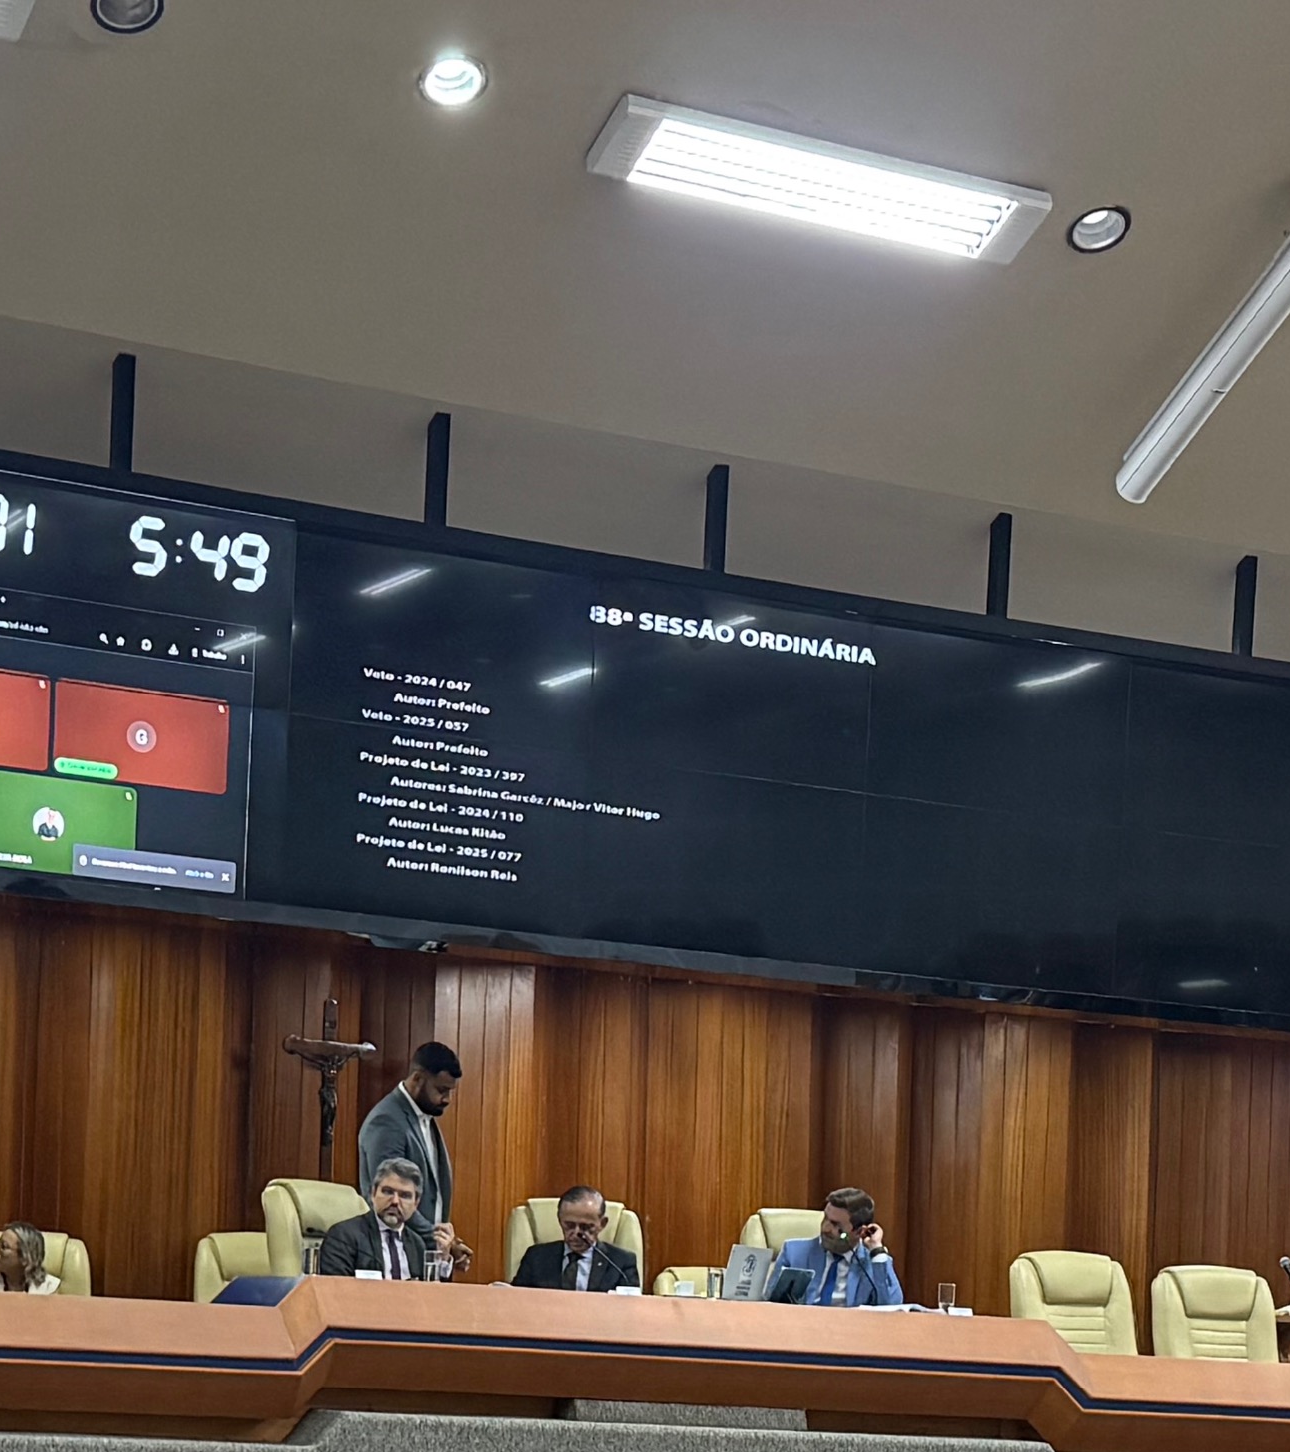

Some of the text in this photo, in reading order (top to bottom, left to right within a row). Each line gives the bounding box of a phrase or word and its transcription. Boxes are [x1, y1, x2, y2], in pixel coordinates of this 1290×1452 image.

[129, 515, 270, 593] 5:49
[639, 612, 735, 643] SESSÃO
[739, 629, 877, 666] ORDINÁRIA
[363, 667, 394, 682] Veto
[404, 674, 437, 688] 2024
[447, 680, 472, 692] 047
[438, 698, 490, 715] Prefeito
[403, 715, 435, 728] 2025
[436, 742, 488, 757] Prefeito
[359, 751, 409, 766] Projeto
[411, 758, 428, 770] de
[430, 761, 450, 773] Lei
[460, 765, 492, 778] 2023
[358, 792, 407, 807] Projeto
[409, 798, 426, 810] de
[429, 801, 448, 813] Lei
[458, 806, 490, 819] 2024
[500, 811, 524, 823] 110
[448, 784, 499, 799] Sabrina
[553, 798, 591, 812] Major
[593, 802, 624, 816] Vitor
[626, 807, 660, 821] Hugo
[432, 822, 469, 836] Lucas
[356, 833, 405, 848] Projeto
[407, 839, 425, 851] de
[427, 842, 446, 854] Lei
[498, 851, 522, 863] 077
[430, 863, 488, 879] Ronilson
[490, 869, 518, 882] Reis
